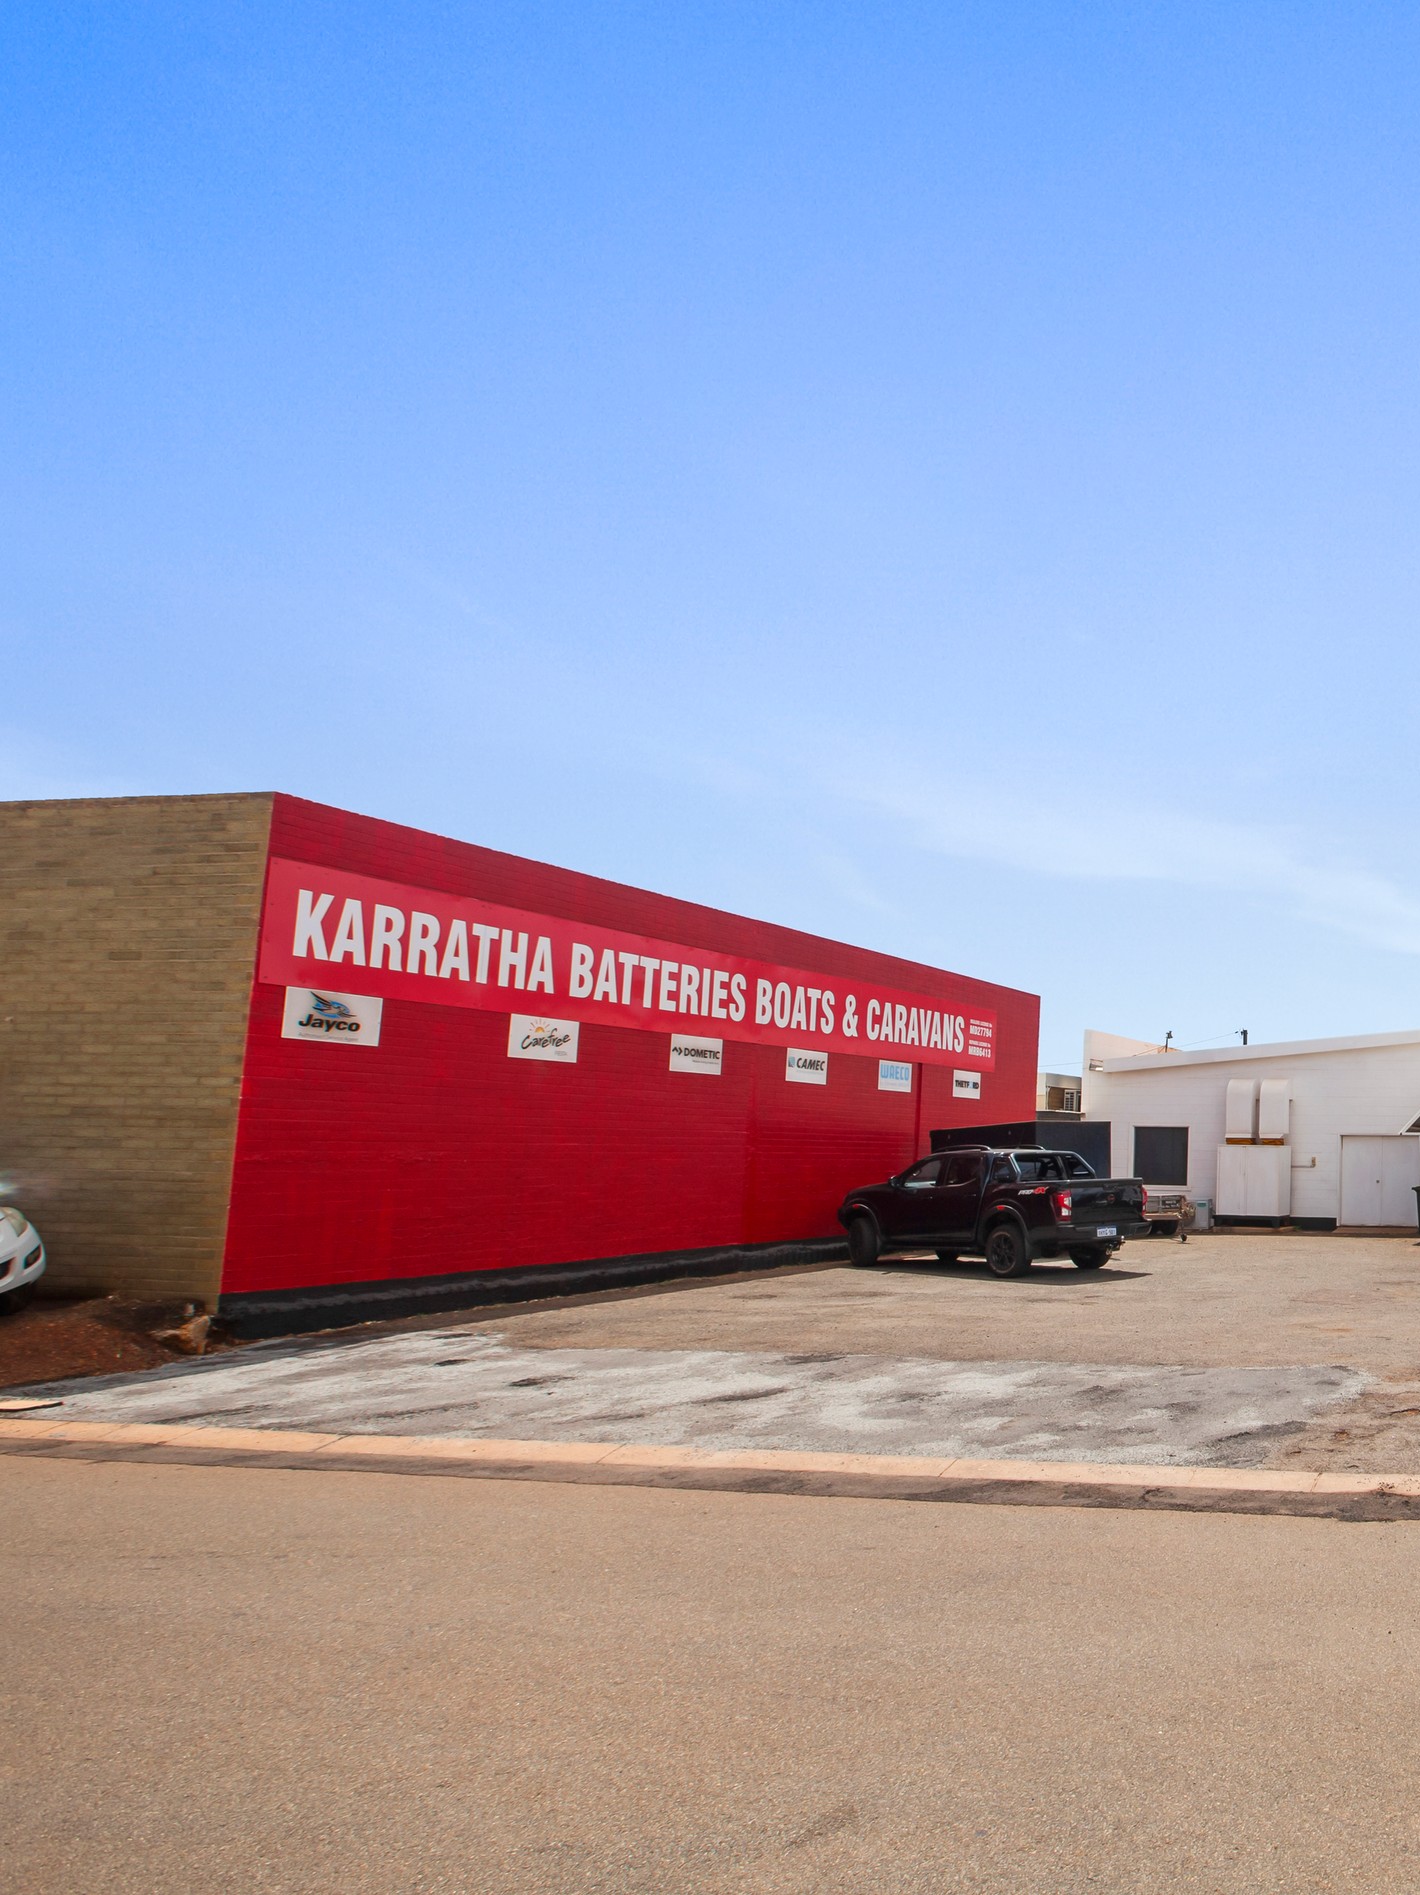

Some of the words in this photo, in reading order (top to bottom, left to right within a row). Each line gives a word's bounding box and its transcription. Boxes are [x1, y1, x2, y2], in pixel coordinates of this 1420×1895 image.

[292, 888, 555, 995] KARRATHA
[568, 942, 747, 1022] BATTERIES
[755, 978, 836, 1035] BOATS
[842, 994, 859, 1038] &
[866, 998, 965, 1053] CARAVANS
[298, 1013, 362, 1033] Jayco
[520, 1027, 571, 1050] Carefree
[683, 1047, 721, 1060] DOMETIC
[796, 1057, 826, 1071] CAMEC
[880, 1063, 910, 1081] WAECO
